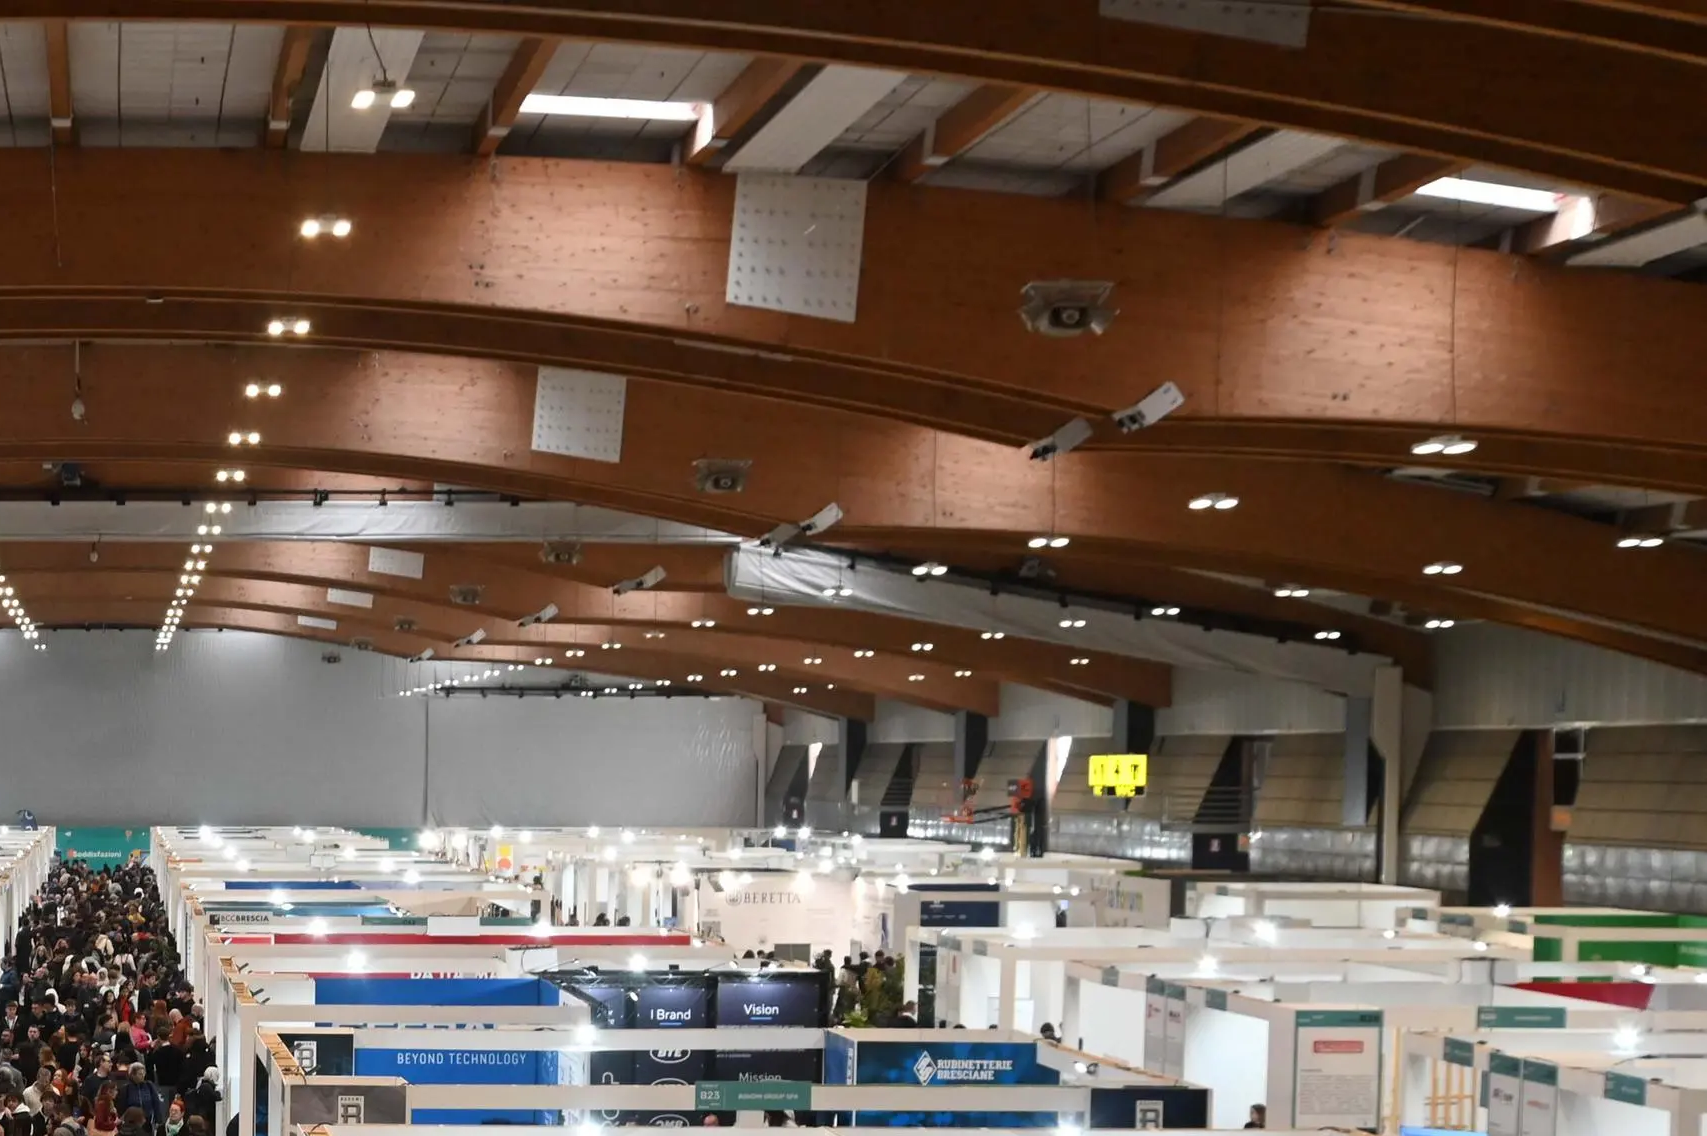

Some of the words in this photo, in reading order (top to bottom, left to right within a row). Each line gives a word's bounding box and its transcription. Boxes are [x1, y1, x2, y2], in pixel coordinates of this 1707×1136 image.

[743, 891, 801, 904] BERETTA
[656, 1008, 691, 1020] Brand
[744, 1003, 780, 1016] Vision
[397, 1052, 444, 1065] BEYOND
[449, 1053, 526, 1065] TECHNOLOGY
[937, 1059, 1013, 1071] RUBINETTERIE
[937, 1070, 995, 1081] BRESCIANE
